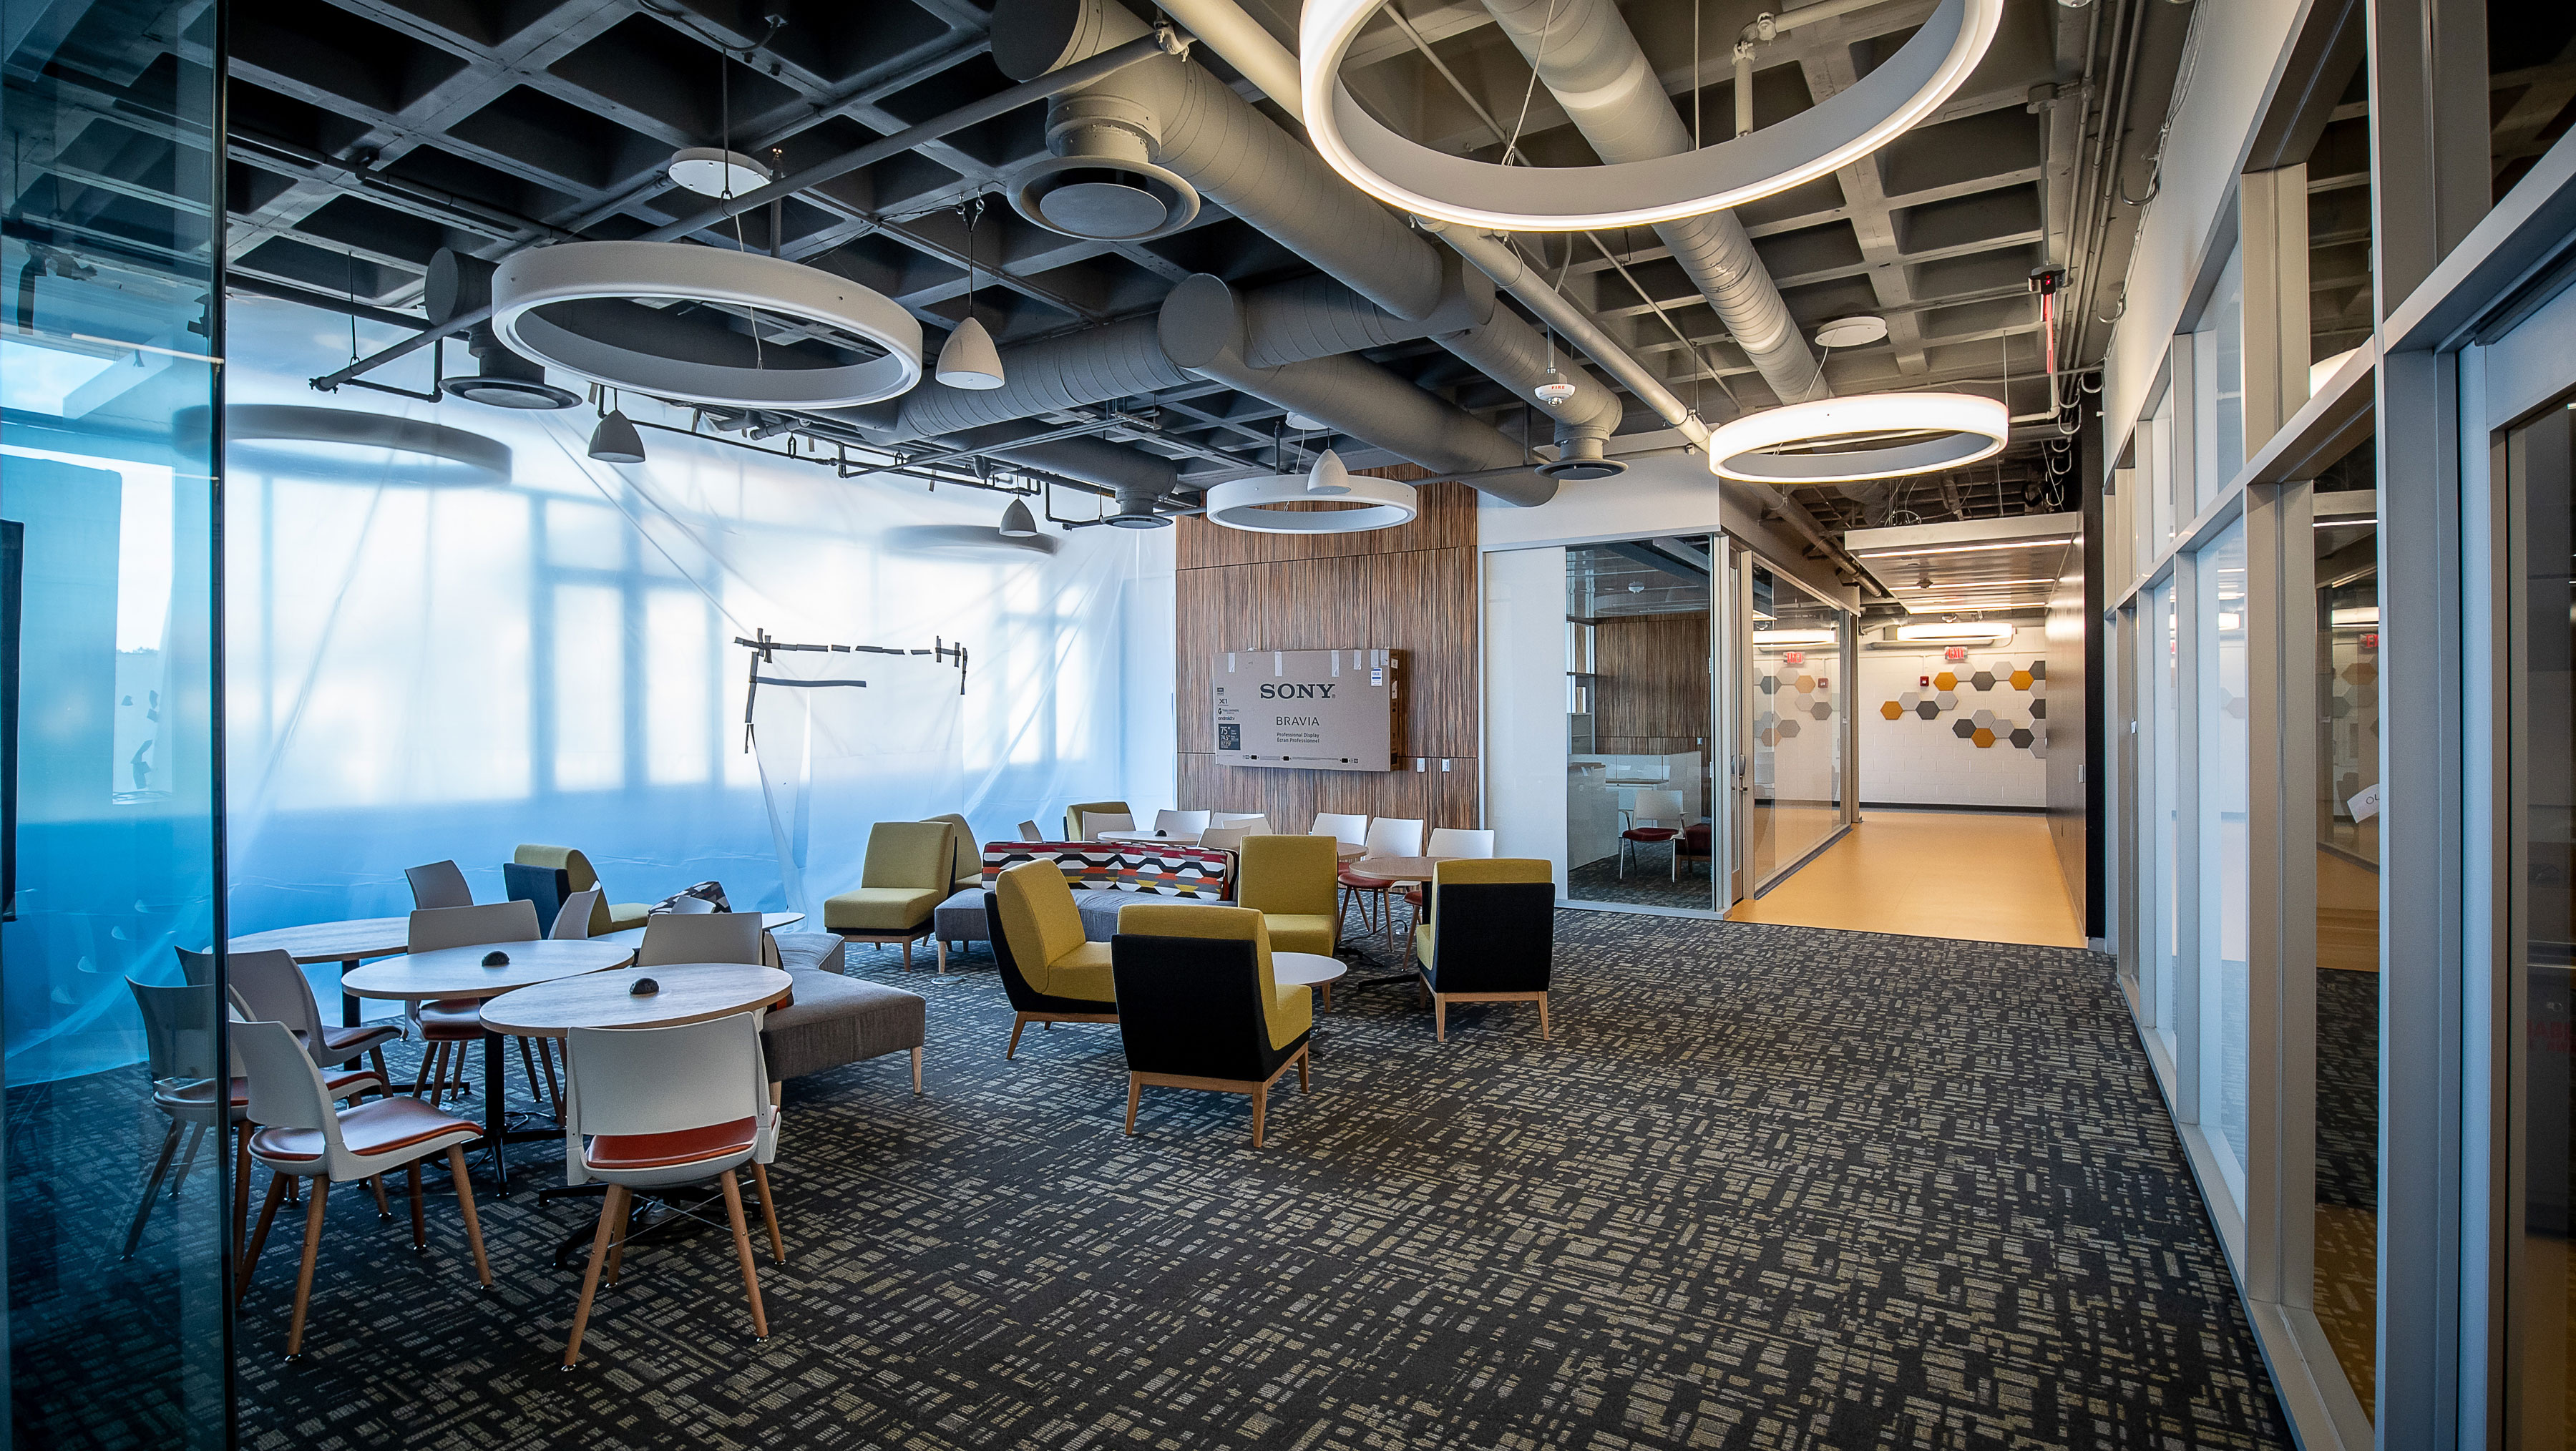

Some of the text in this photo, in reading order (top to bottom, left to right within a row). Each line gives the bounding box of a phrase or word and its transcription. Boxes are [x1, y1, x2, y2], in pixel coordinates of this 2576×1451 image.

[1948, 648, 1963, 658] EXIT
[1260, 683, 1335, 699] SONY
[1277, 717, 1319, 726] BRAVIA
